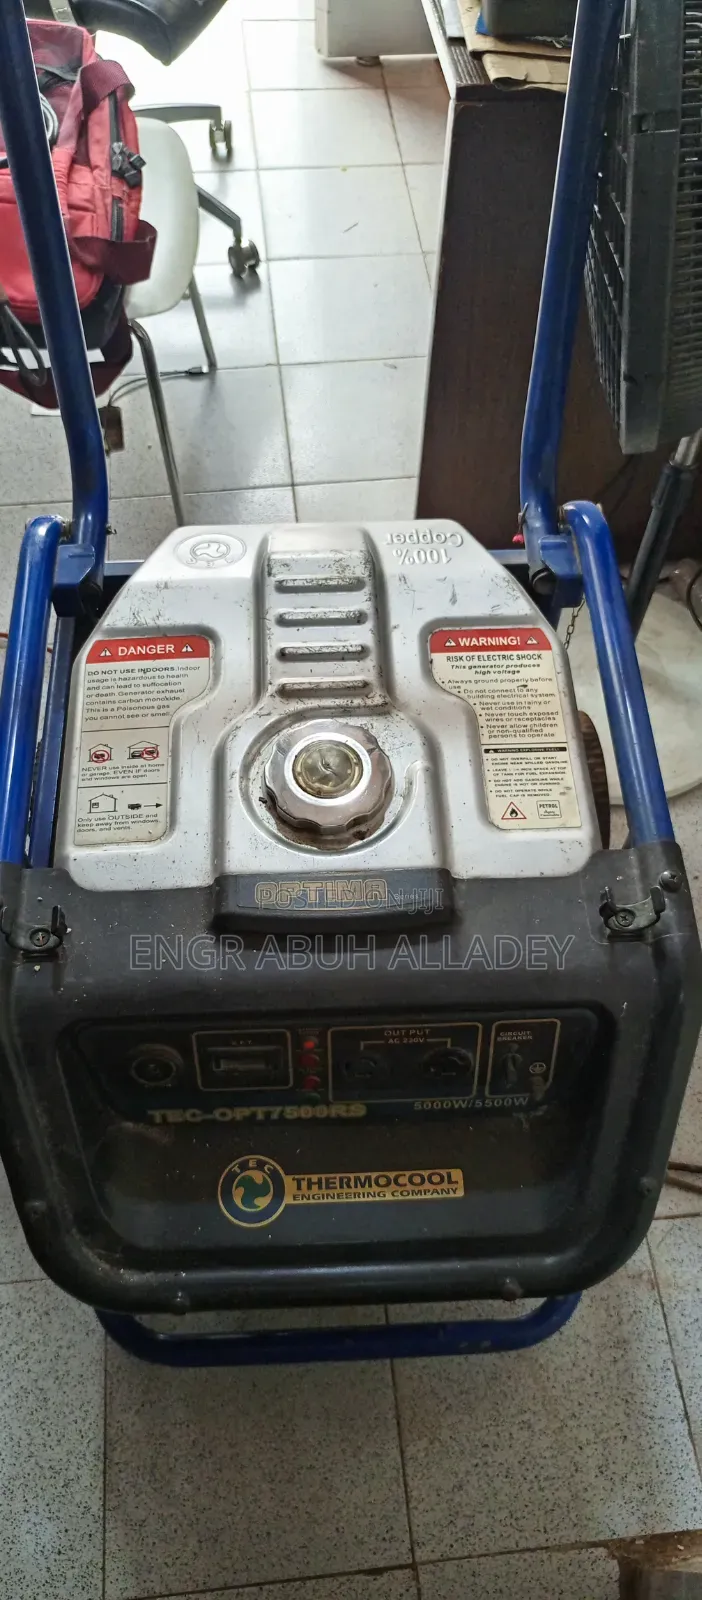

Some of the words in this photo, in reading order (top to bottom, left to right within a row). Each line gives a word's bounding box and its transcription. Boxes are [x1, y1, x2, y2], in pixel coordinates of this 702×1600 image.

[385, 528, 464, 547] Copper
[392, 548, 452, 565] 100%
[458, 636, 520, 646] WARNING!
[118, 644, 174, 656] DANGER
[414, 1097, 529, 1110] 5000W/5500W
[231, 1159, 274, 1174] TEC
[292, 1172, 458, 1191] THERMOCOOL
[292, 1190, 386, 1201] ENGINEERING
[391, 1188, 458, 1197] COMPANY
